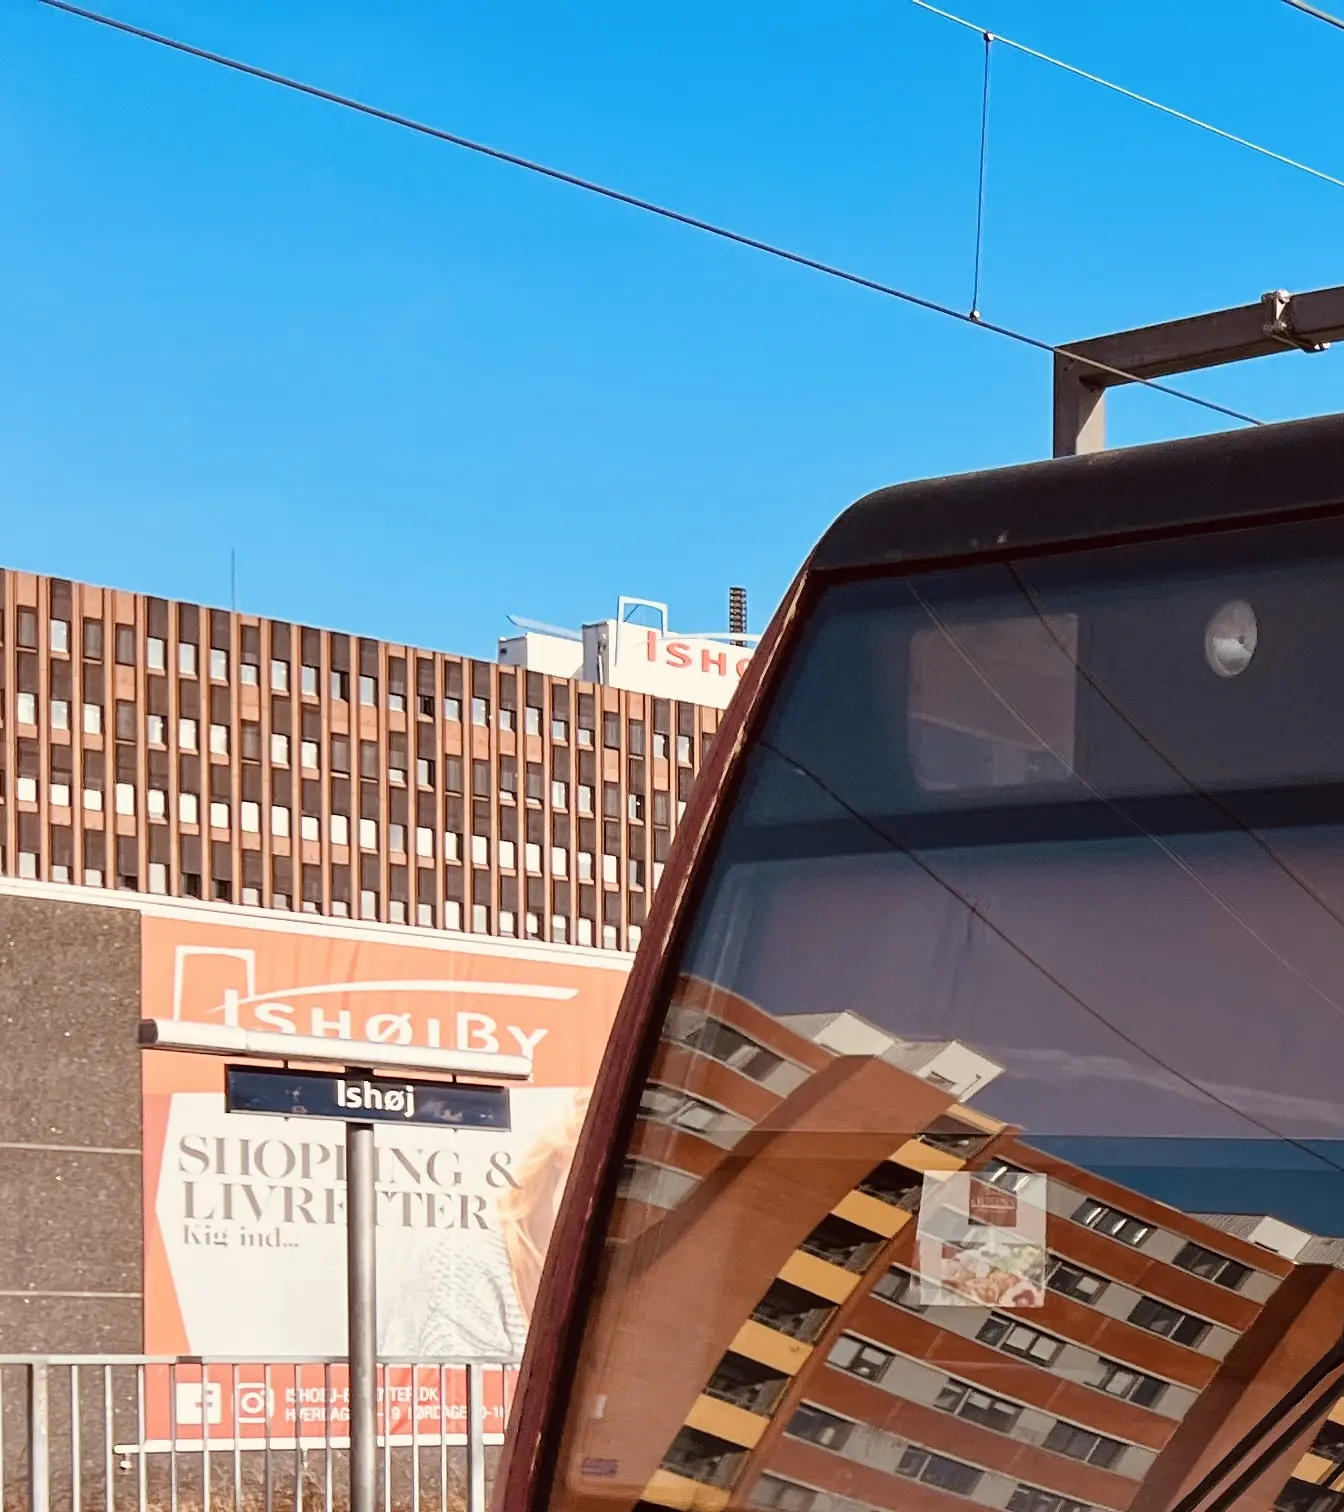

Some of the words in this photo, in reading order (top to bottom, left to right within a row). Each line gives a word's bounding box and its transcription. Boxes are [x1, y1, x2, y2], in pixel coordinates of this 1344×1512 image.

[337, 1079, 415, 1118] Ishøj
[485, 1150, 524, 1190] &
[183, 1224, 229, 1248] Kig
